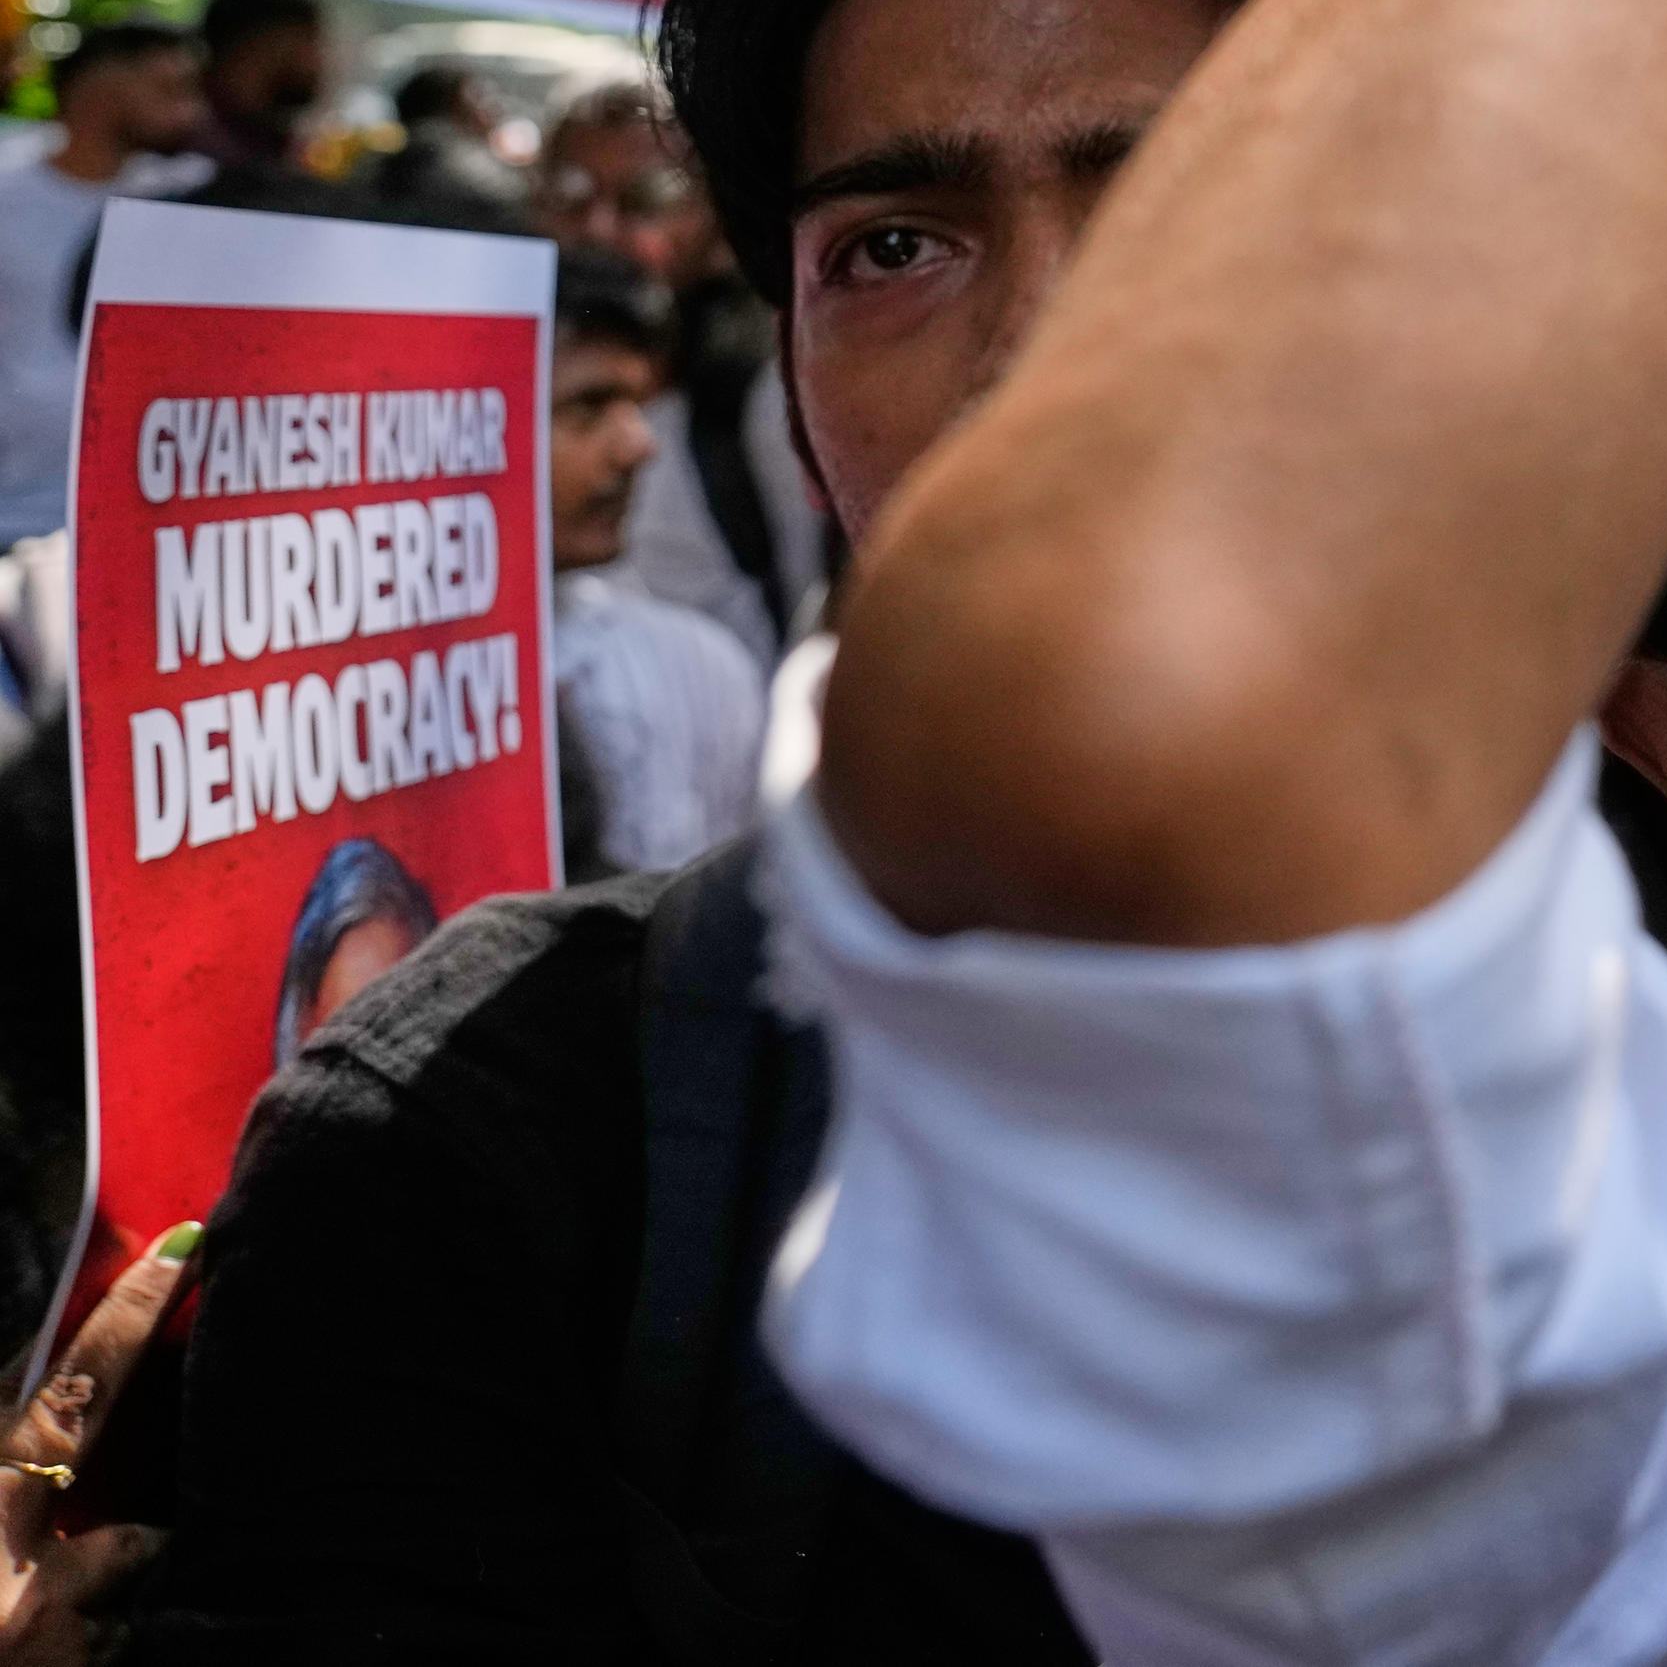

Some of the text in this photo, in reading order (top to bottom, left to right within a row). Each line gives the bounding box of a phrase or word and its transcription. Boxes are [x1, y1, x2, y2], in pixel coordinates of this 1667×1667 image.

[138, 386, 508, 504] GYANESH KUMAR
[154, 492, 499, 675] MURDERED
[129, 633, 523, 864] DEMOCRACY!
